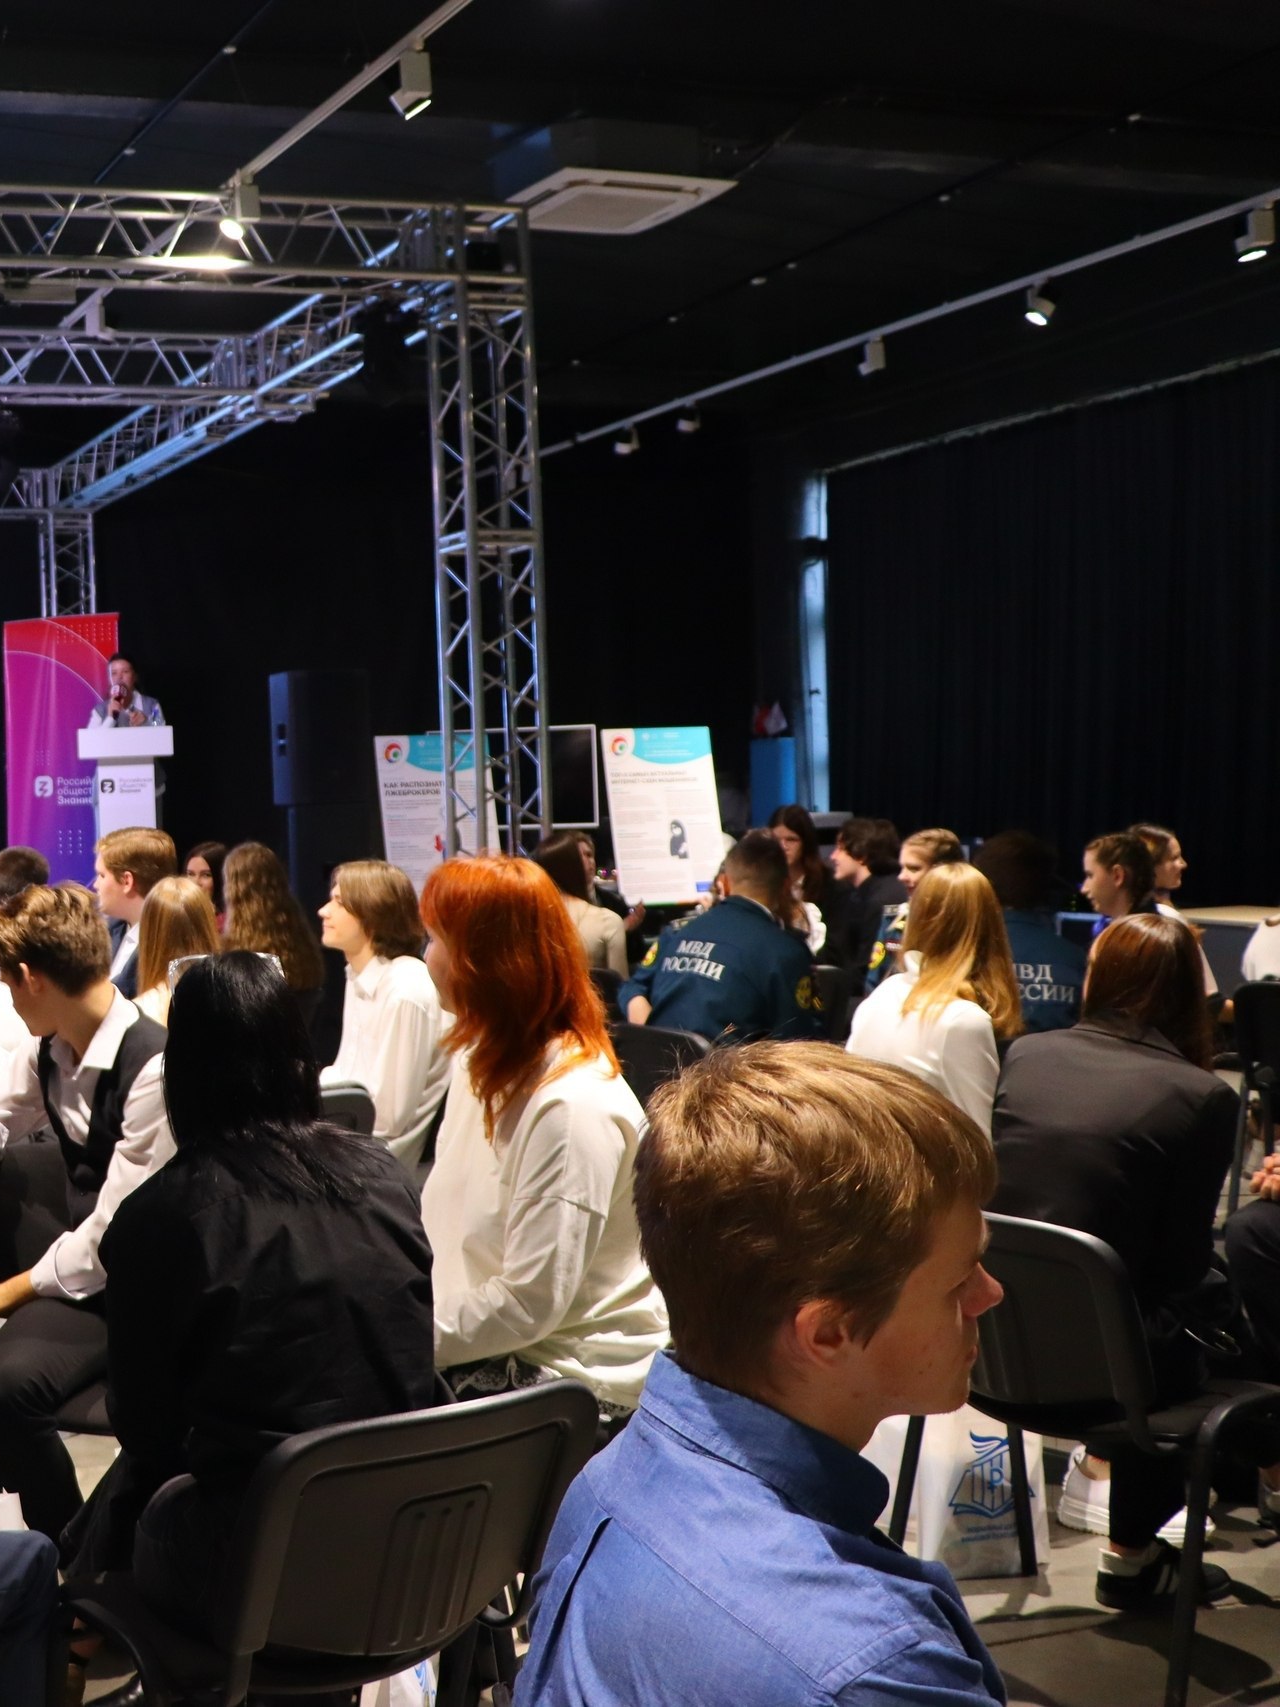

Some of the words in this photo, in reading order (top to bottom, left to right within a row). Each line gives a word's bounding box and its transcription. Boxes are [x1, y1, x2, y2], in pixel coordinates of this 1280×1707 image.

[57, 785, 93, 796] общест
[676, 940, 716, 959] МВД
[1017, 983, 1075, 1003] ССИИ
